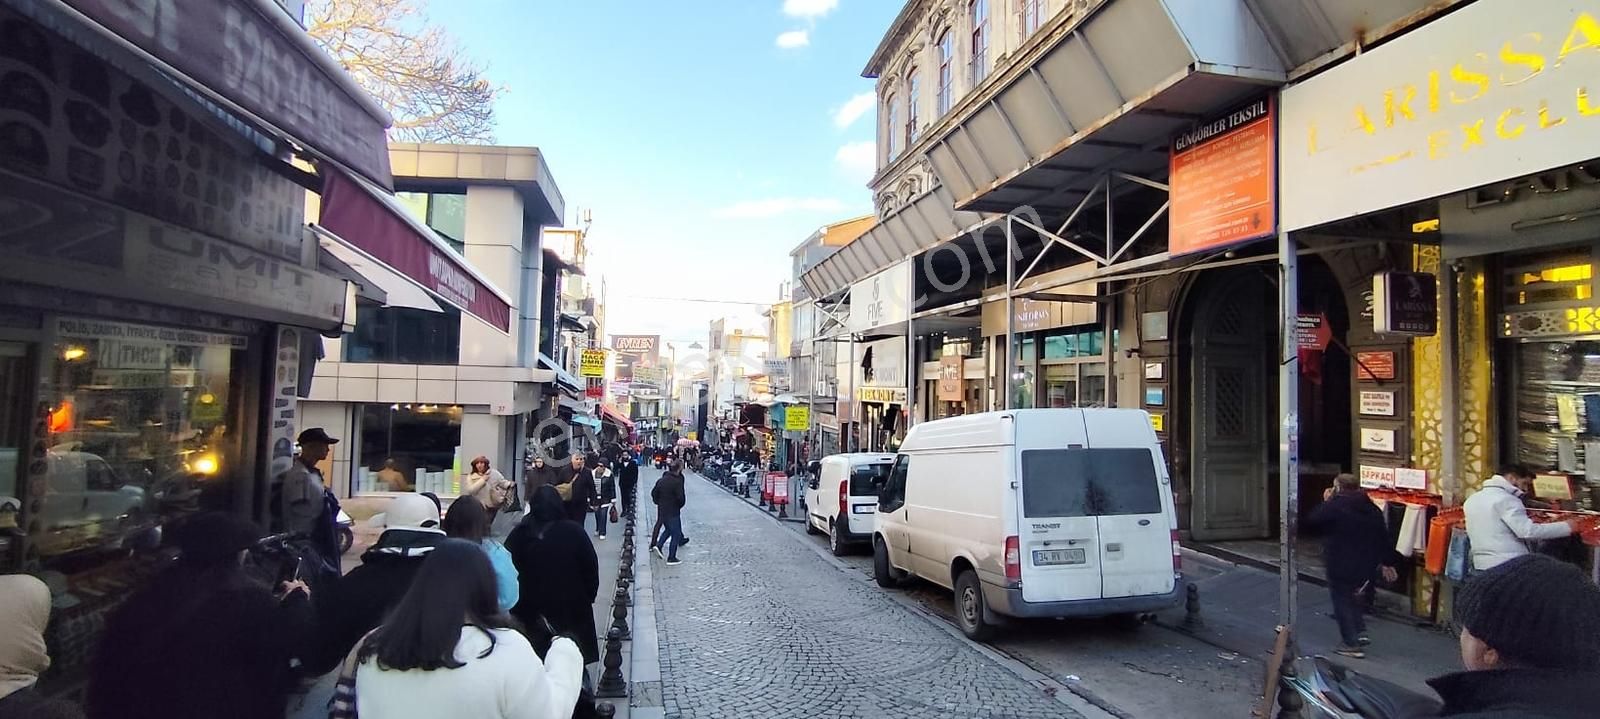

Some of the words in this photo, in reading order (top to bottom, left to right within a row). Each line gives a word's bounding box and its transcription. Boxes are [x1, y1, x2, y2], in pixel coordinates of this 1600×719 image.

[867, 301, 883, 321] FIVE
[616, 337, 655, 349] EVREN
[1039, 553, 1048, 561] 34
